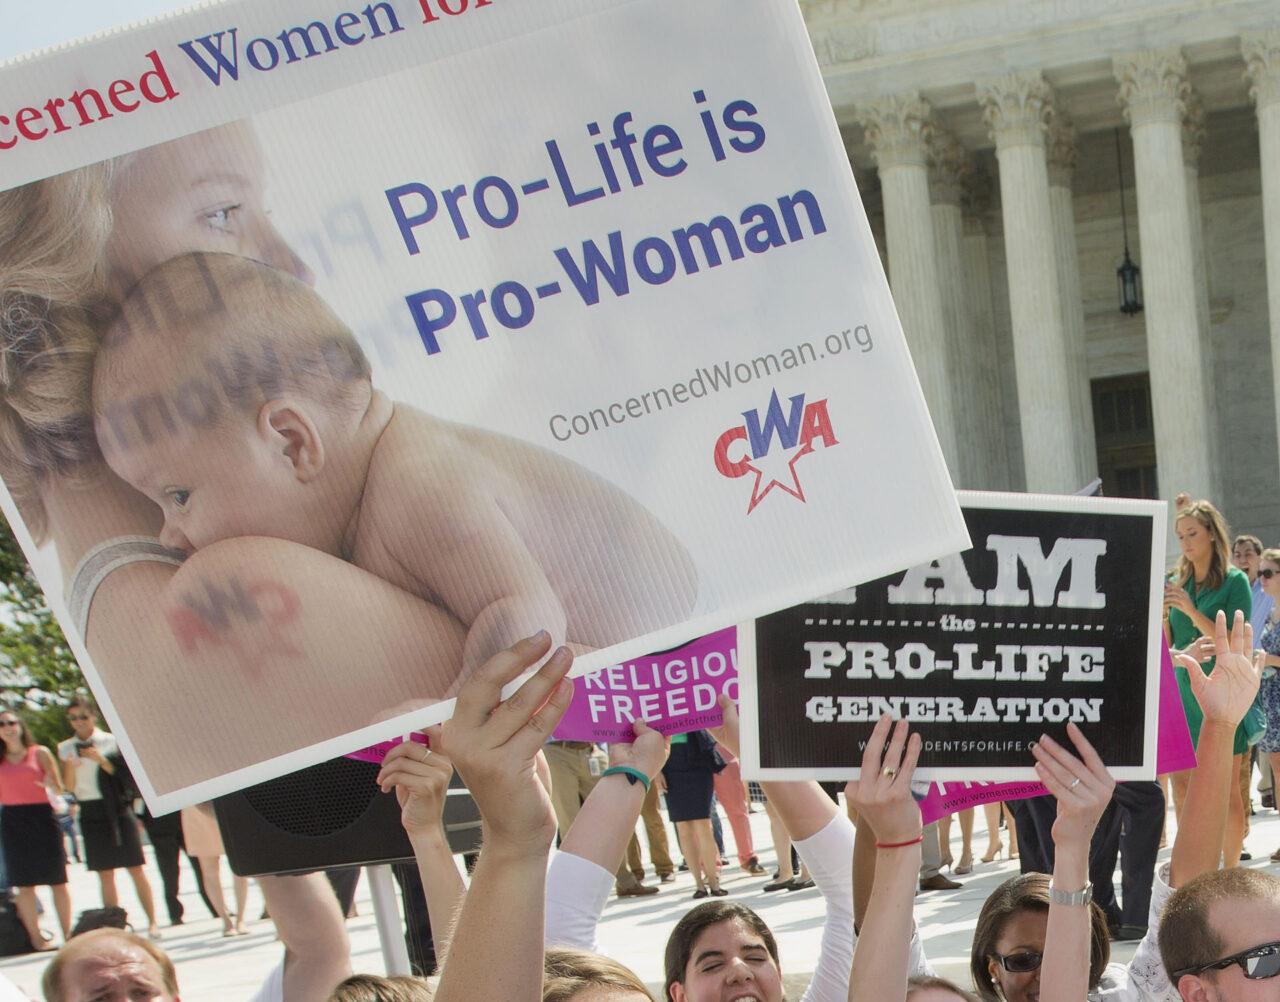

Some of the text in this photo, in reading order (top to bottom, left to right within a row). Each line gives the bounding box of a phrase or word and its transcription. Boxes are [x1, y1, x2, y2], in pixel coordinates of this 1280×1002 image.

[178, 1, 404, 87] Women
[384, 89, 766, 256] Pro-Life is
[404, 188, 828, 356] Pro-Woman
[549, 323, 874, 442] ConcernedWoman.org
[714, 386, 840, 478] CWA
[887, 534, 1107, 609] AM
[804, 641, 1105, 682] PRO-LIFE
[939, 614, 977, 632] the
[805, 696, 1104, 724] GENERATION
